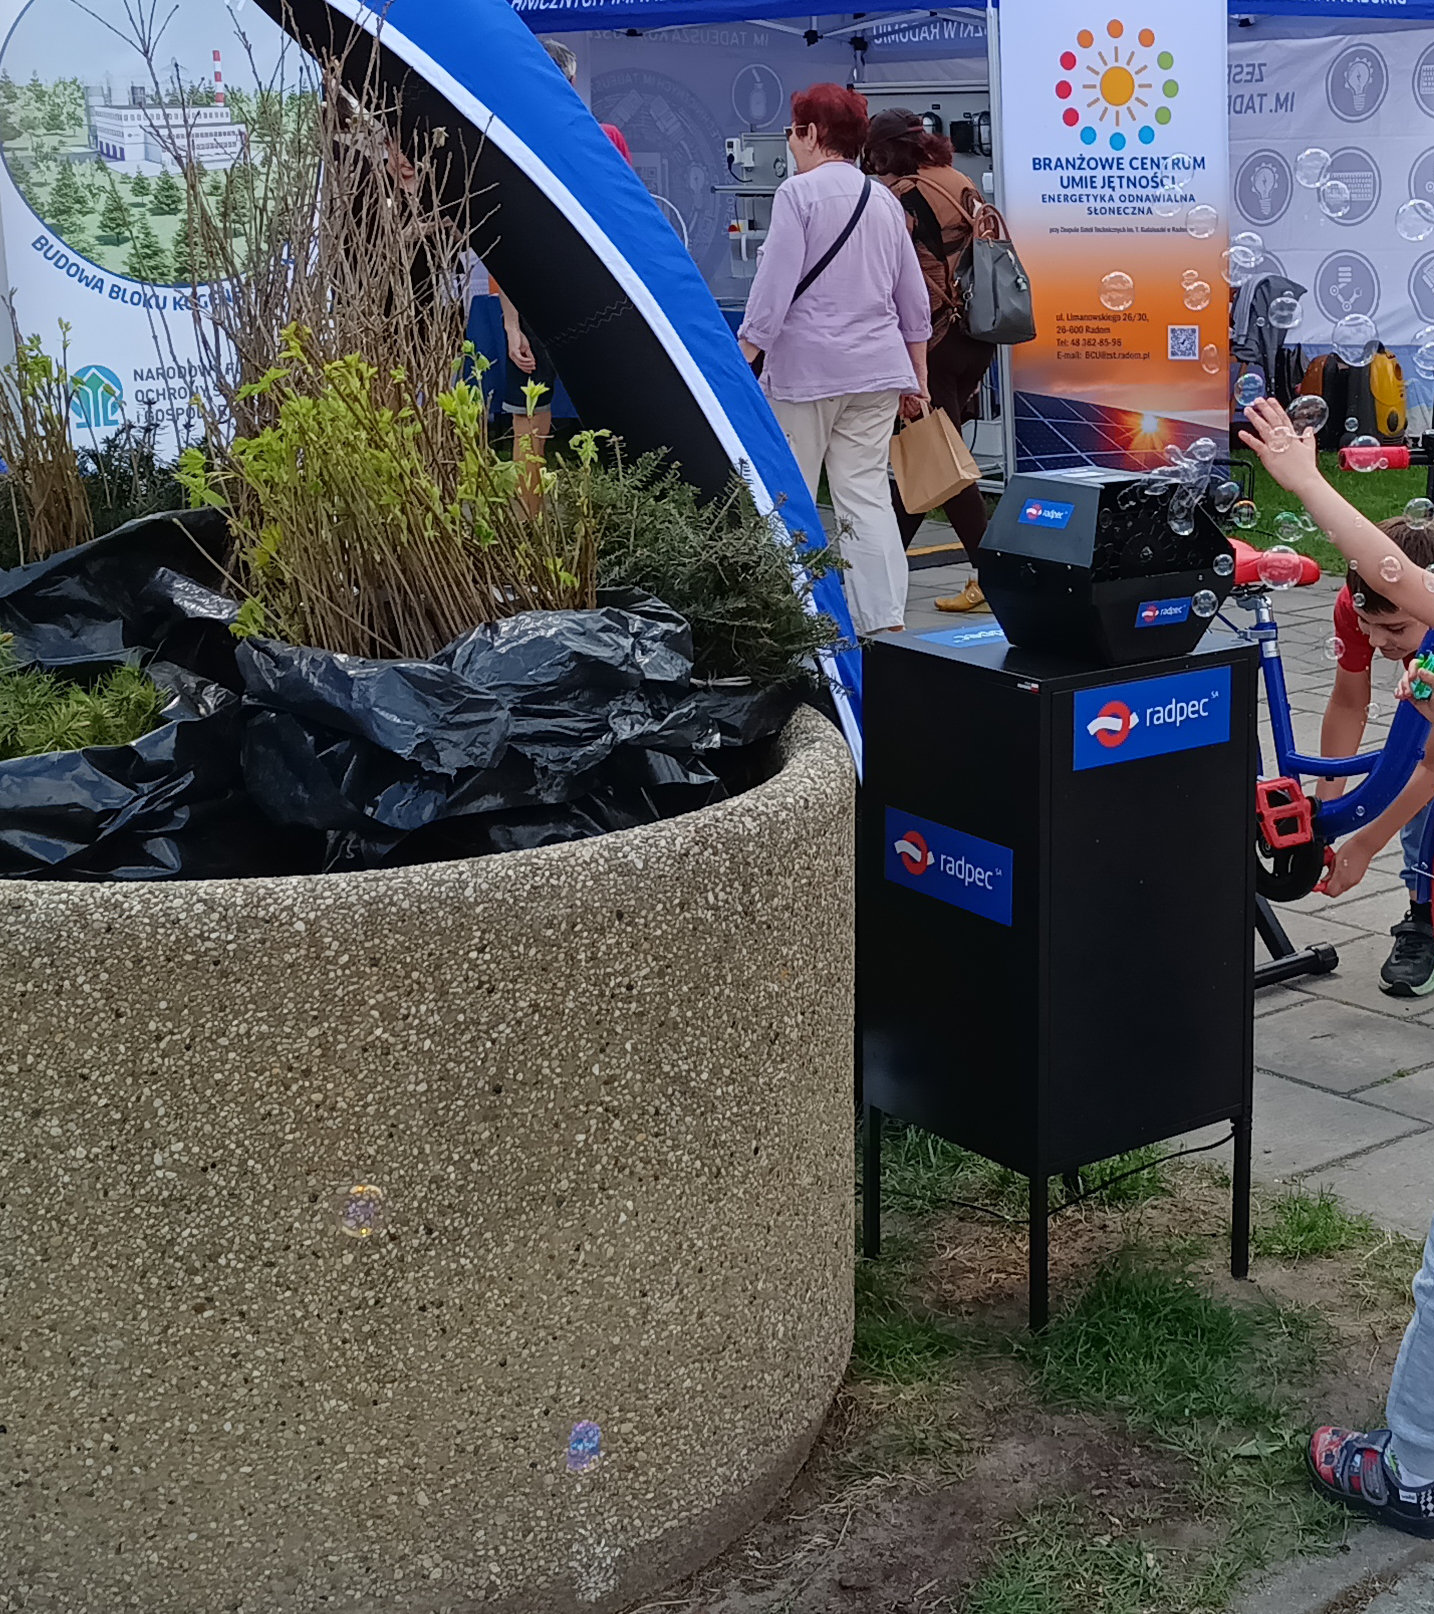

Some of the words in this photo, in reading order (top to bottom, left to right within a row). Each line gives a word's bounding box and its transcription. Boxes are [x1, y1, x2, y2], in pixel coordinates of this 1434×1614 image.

[1032, 154, 1125, 171] BRANŻOWE
[1129, 156, 1206, 171] CENTRUM
[1041, 194, 1115, 203] ENERGETYKA
[1118, 194, 1196, 203] ODNAWIALNA
[1087, 206, 1153, 216] SŁONECZNA
[31, 234, 104, 294] BUDOWA
[108, 284, 167, 311] BLOKU
[1146, 696, 1209, 727] radpec
[940, 853, 993, 890] radpec
